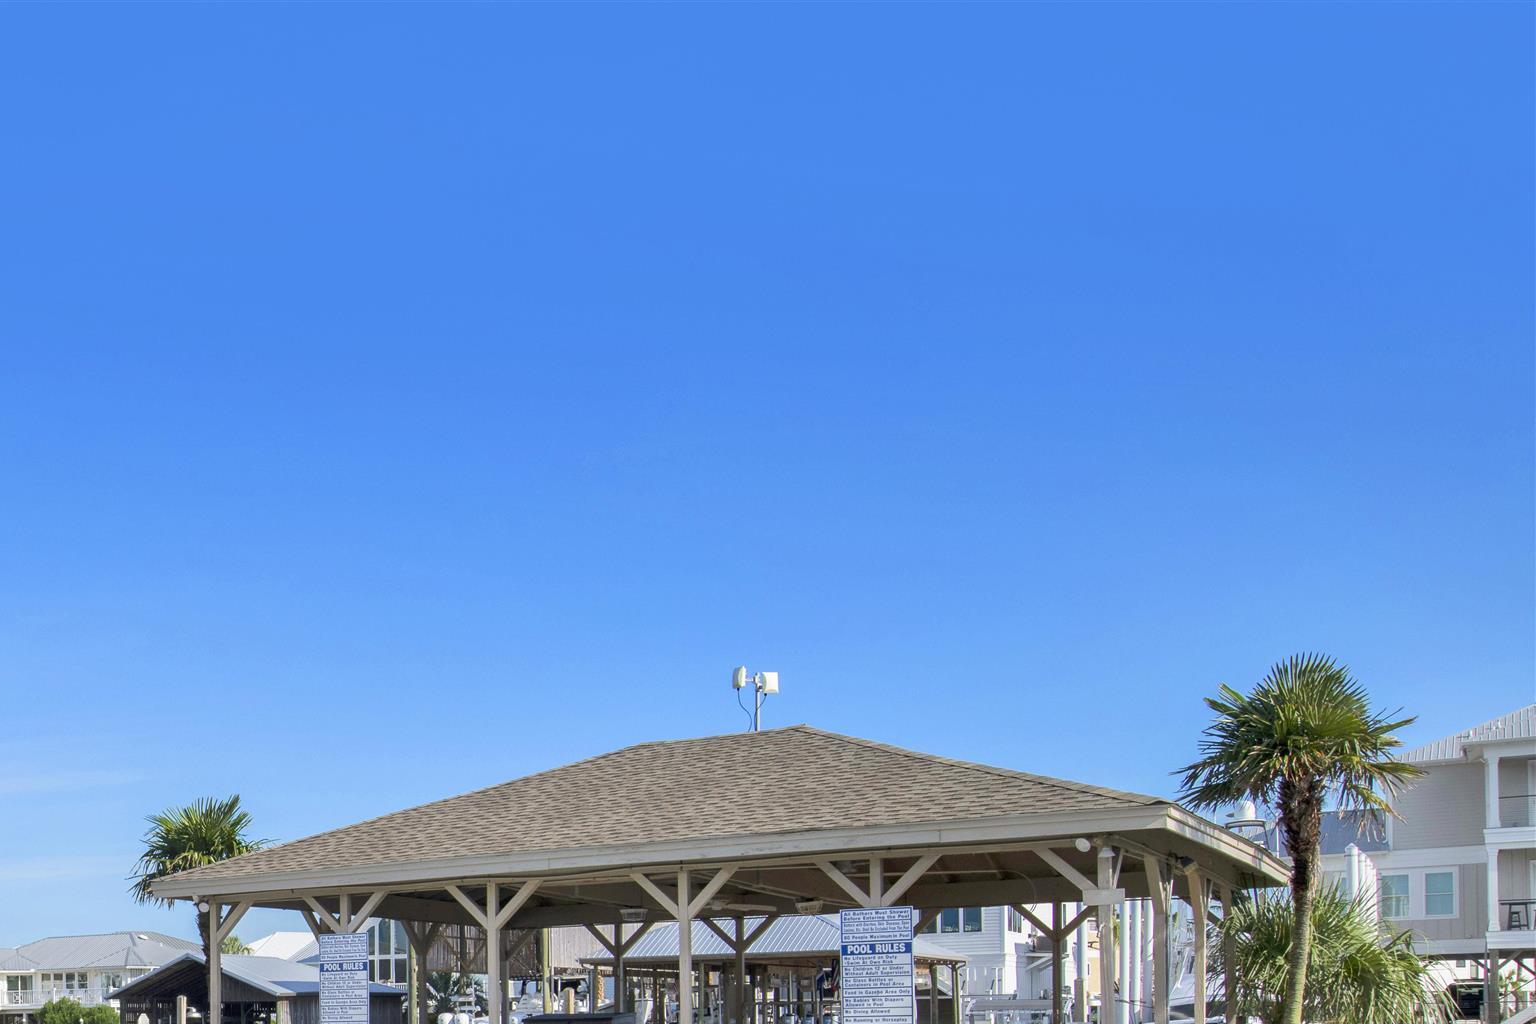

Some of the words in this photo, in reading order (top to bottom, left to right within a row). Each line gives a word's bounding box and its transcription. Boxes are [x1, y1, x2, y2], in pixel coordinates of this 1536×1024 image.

[848, 944, 872, 954] POOL
[876, 943, 906, 953] RULES
[343, 962, 364, 970] RULES
